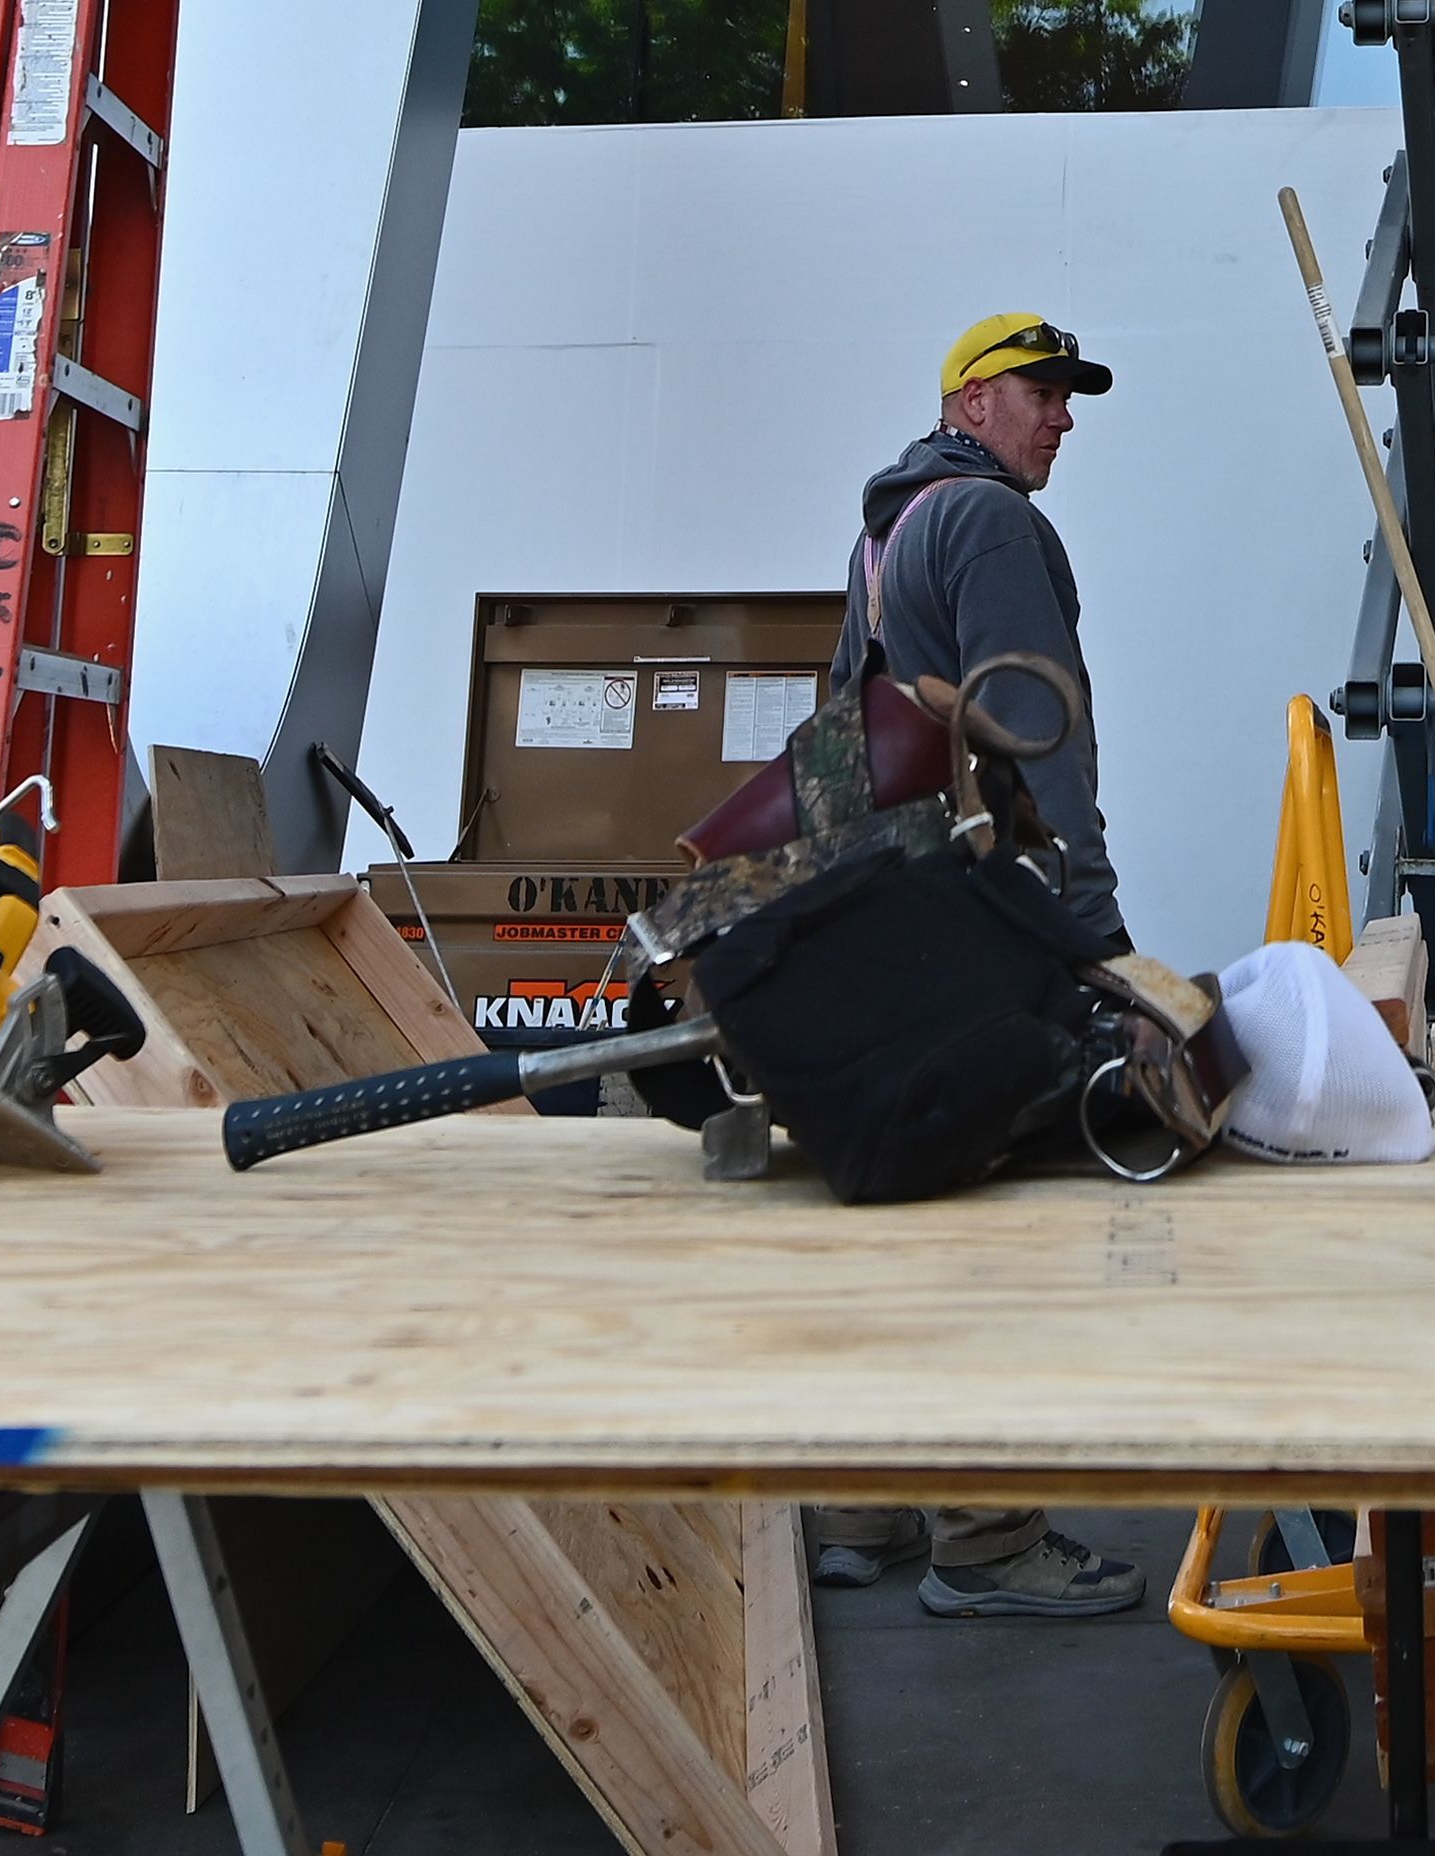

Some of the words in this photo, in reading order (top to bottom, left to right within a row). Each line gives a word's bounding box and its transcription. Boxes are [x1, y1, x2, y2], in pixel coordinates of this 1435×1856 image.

[1309, 883, 1327, 950] O'KA
[496, 927, 601, 940] JOBMASTER
[474, 997, 679, 1029] KNAAC
